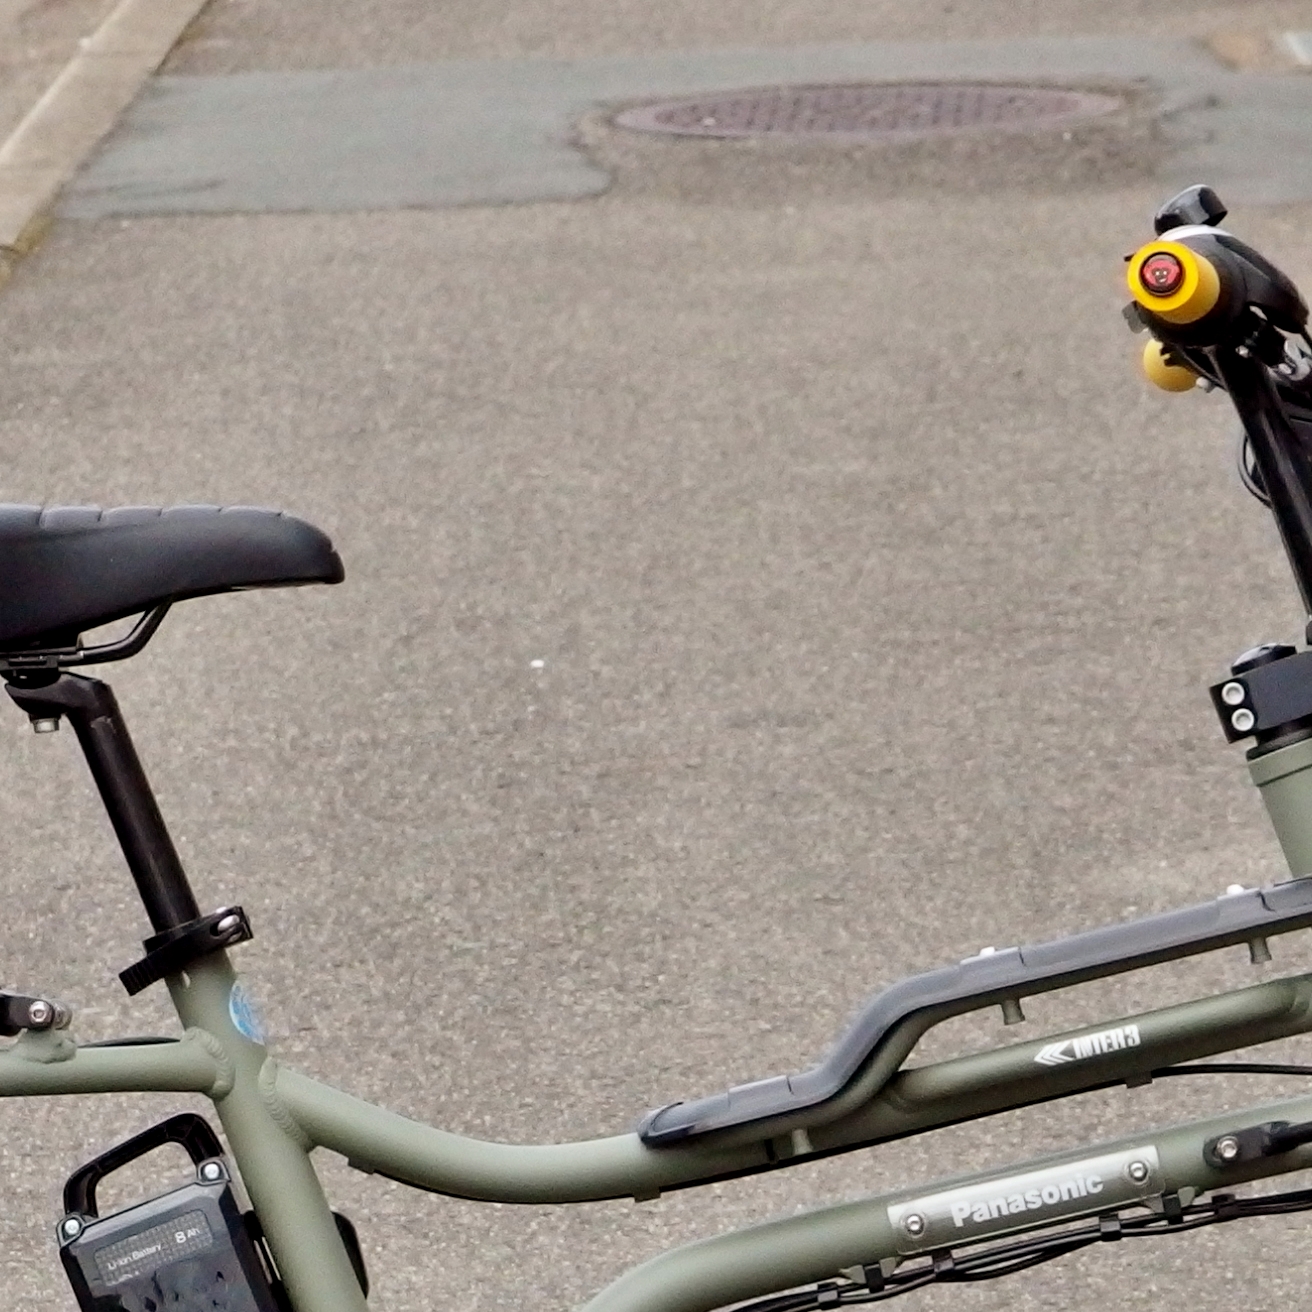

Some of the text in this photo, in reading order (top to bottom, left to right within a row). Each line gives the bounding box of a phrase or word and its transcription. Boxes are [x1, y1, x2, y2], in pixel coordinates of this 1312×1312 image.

[950, 1174, 1103, 1227] Panasonic
[132, 1243, 161, 1260] Battery
[175, 1231, 187, 1243] 8
[187, 1228, 201, 1238] Ah
